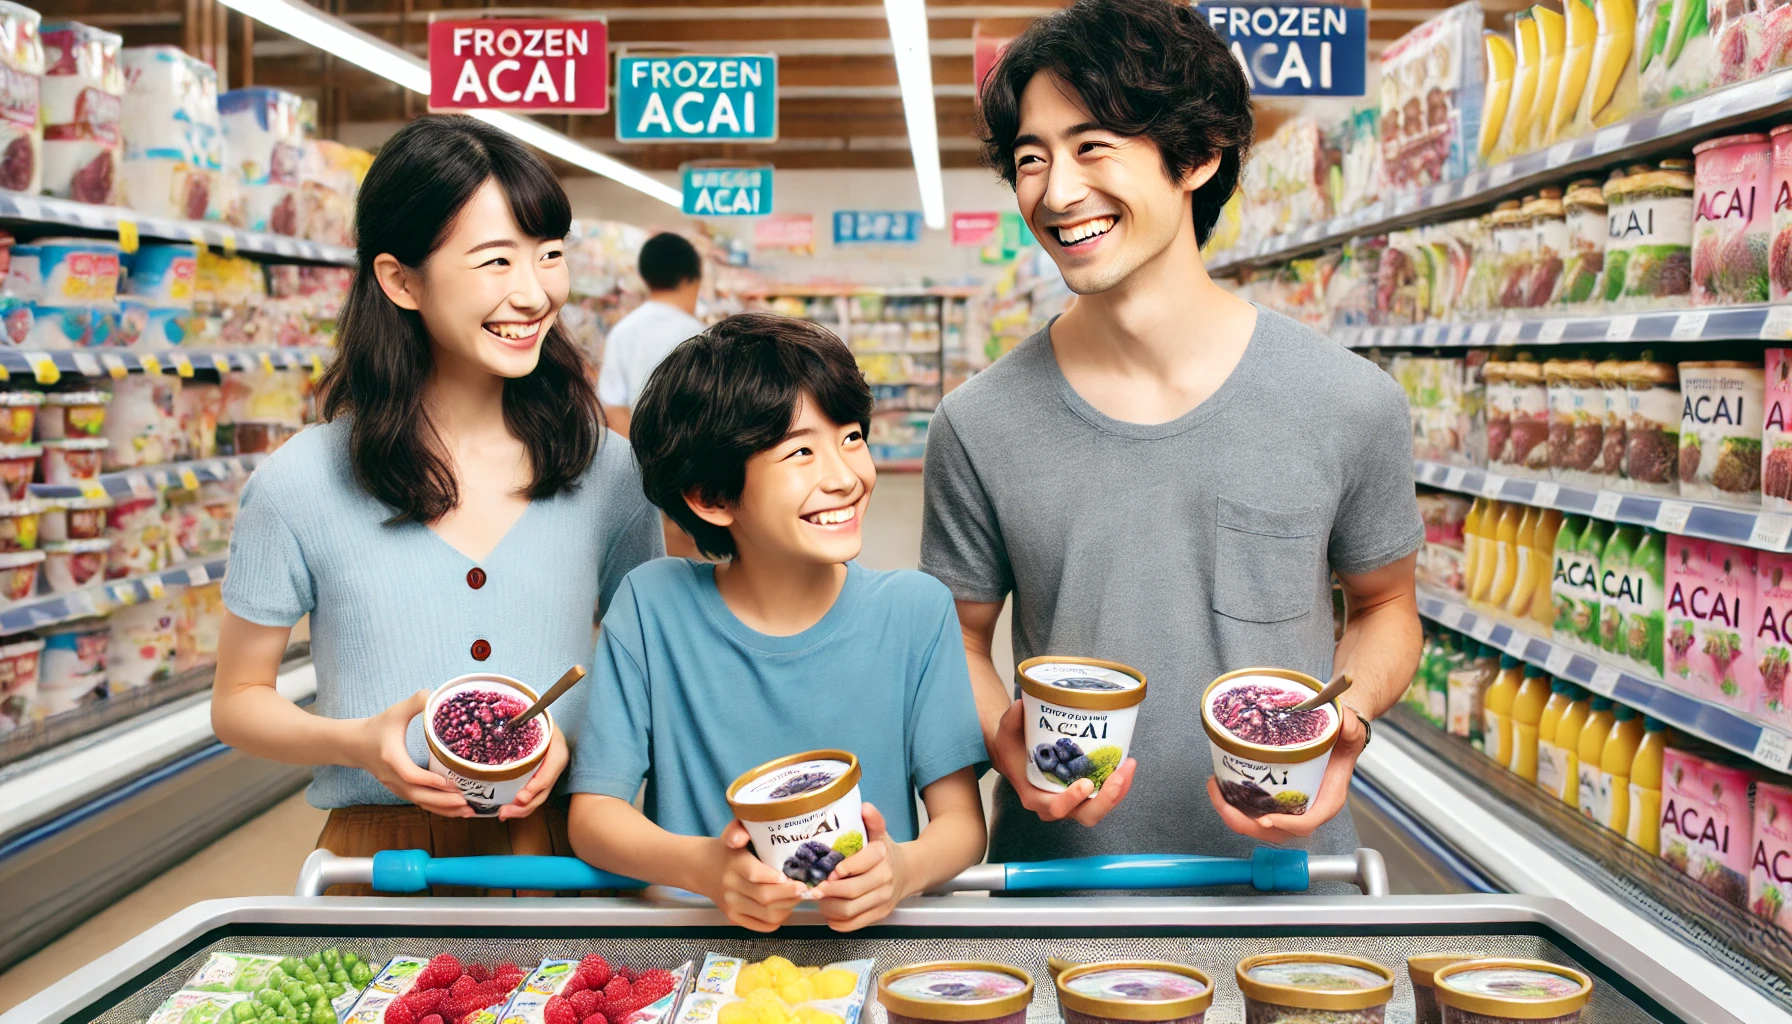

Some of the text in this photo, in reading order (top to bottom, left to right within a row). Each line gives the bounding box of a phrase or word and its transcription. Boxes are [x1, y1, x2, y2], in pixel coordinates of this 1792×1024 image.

[1208, 7, 1347, 37] FROZEN
[453, 28, 589, 57] FROZEN
[452, 59, 577, 104] ACAI
[632, 60, 763, 89] FROZEN
[636, 91, 756, 134] ACAI
[693, 187, 761, 214] ACAI
[1682, 395, 1743, 426] ACAI
[1602, 569, 1643, 605] CAI
[1667, 582, 1740, 628] ACAI
[1661, 798, 1729, 854] ACAI
